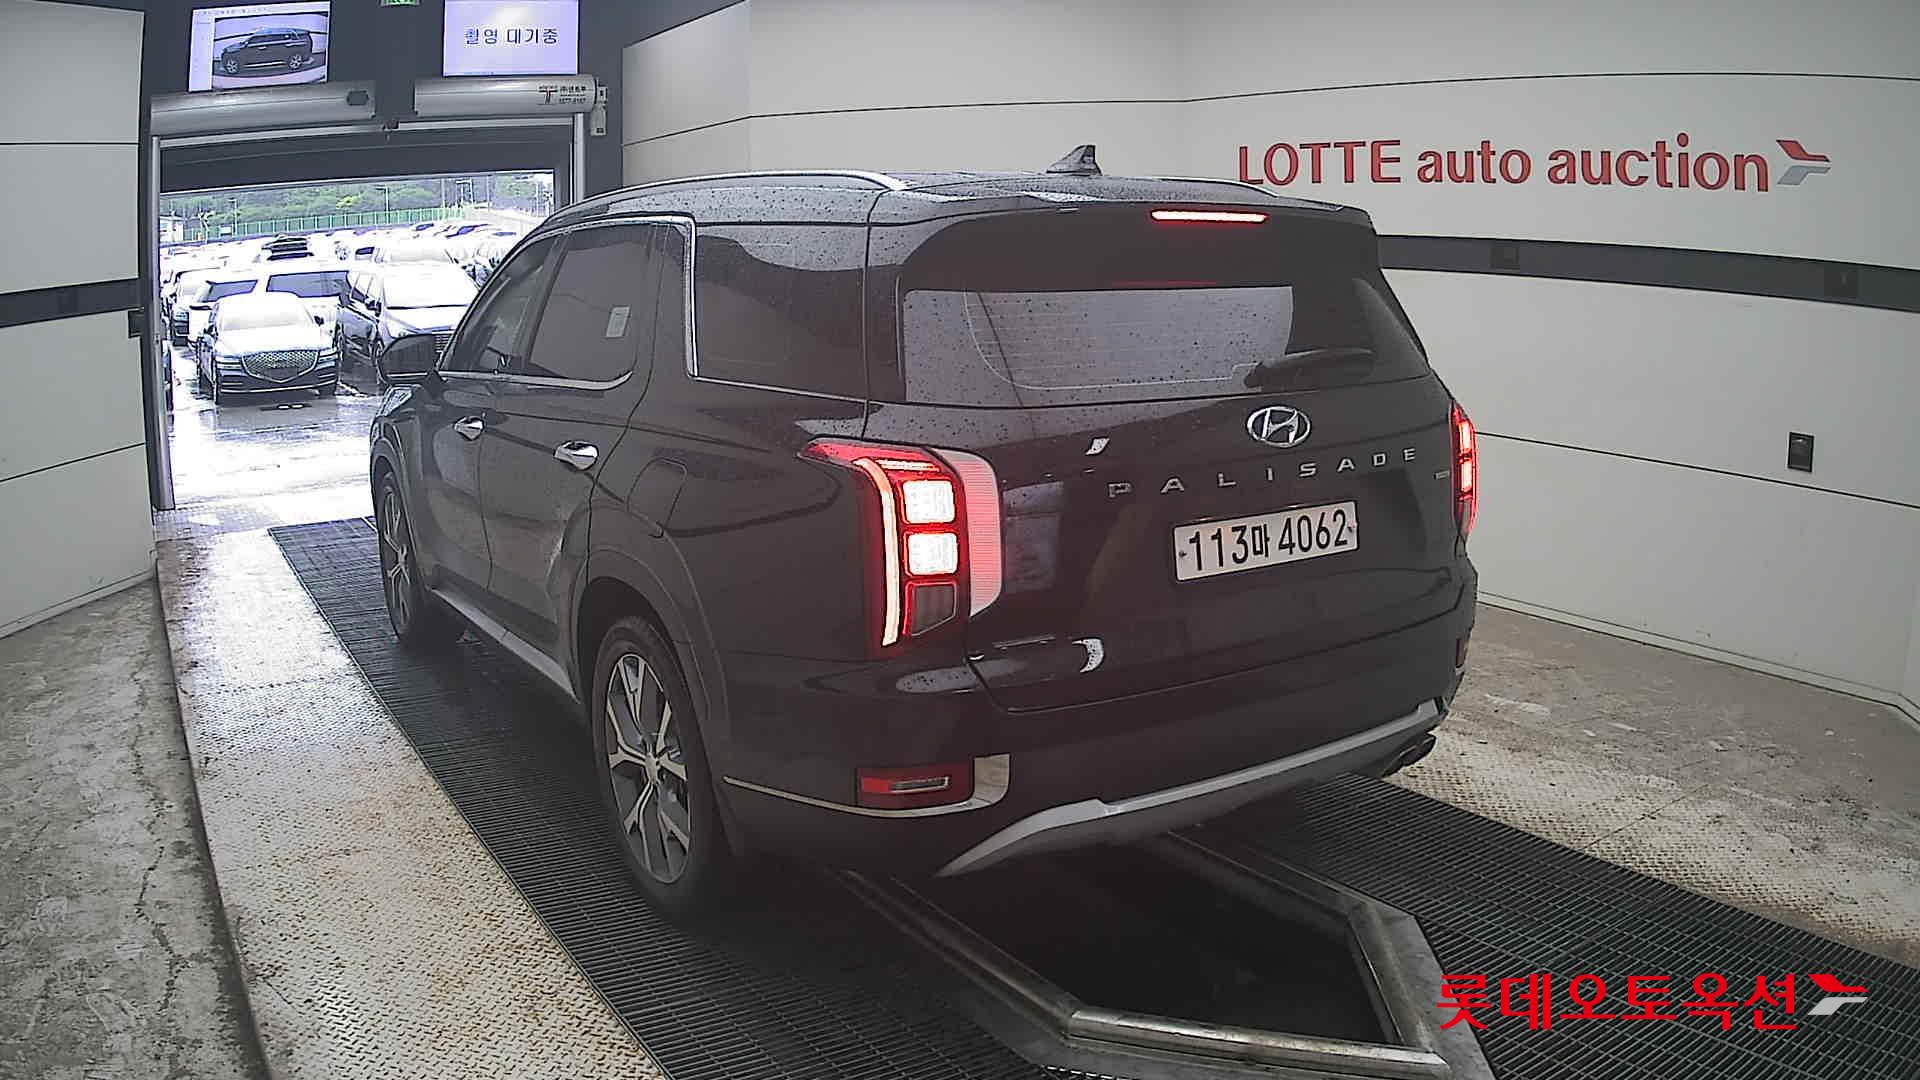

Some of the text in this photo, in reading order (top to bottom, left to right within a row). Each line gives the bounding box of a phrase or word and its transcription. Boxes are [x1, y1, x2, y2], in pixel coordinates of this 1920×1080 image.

[506, 28, 560, 45] 대기중
[1238, 132, 1771, 192] LOTTE auto auction
[1107, 447, 1417, 498] PALISADE
[1189, 508, 1348, 571] 113마 4062
